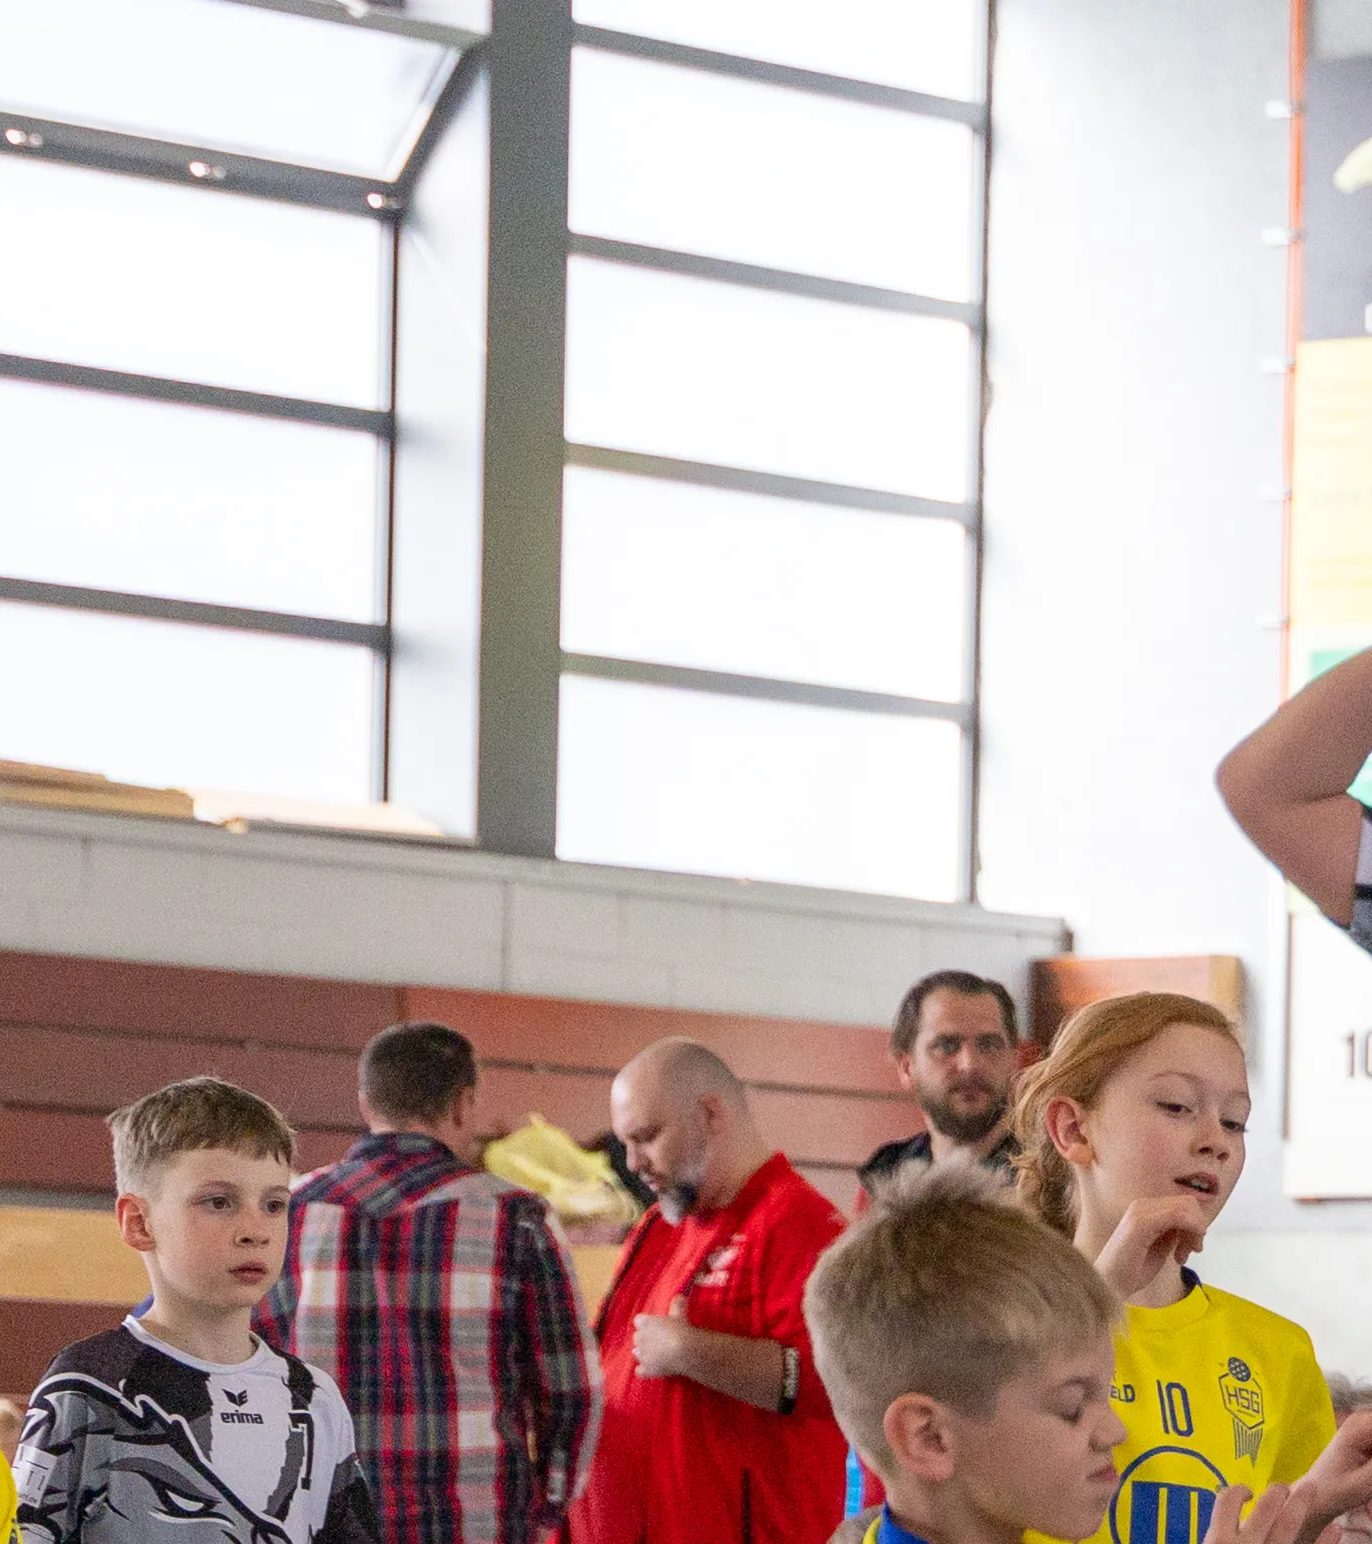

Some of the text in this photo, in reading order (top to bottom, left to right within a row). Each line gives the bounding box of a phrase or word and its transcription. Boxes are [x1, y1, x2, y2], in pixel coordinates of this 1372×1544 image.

[1156, 1379, 1195, 1437] 10
[1228, 1386, 1261, 1414] HSG
[221, 1410, 264, 1425] erima
